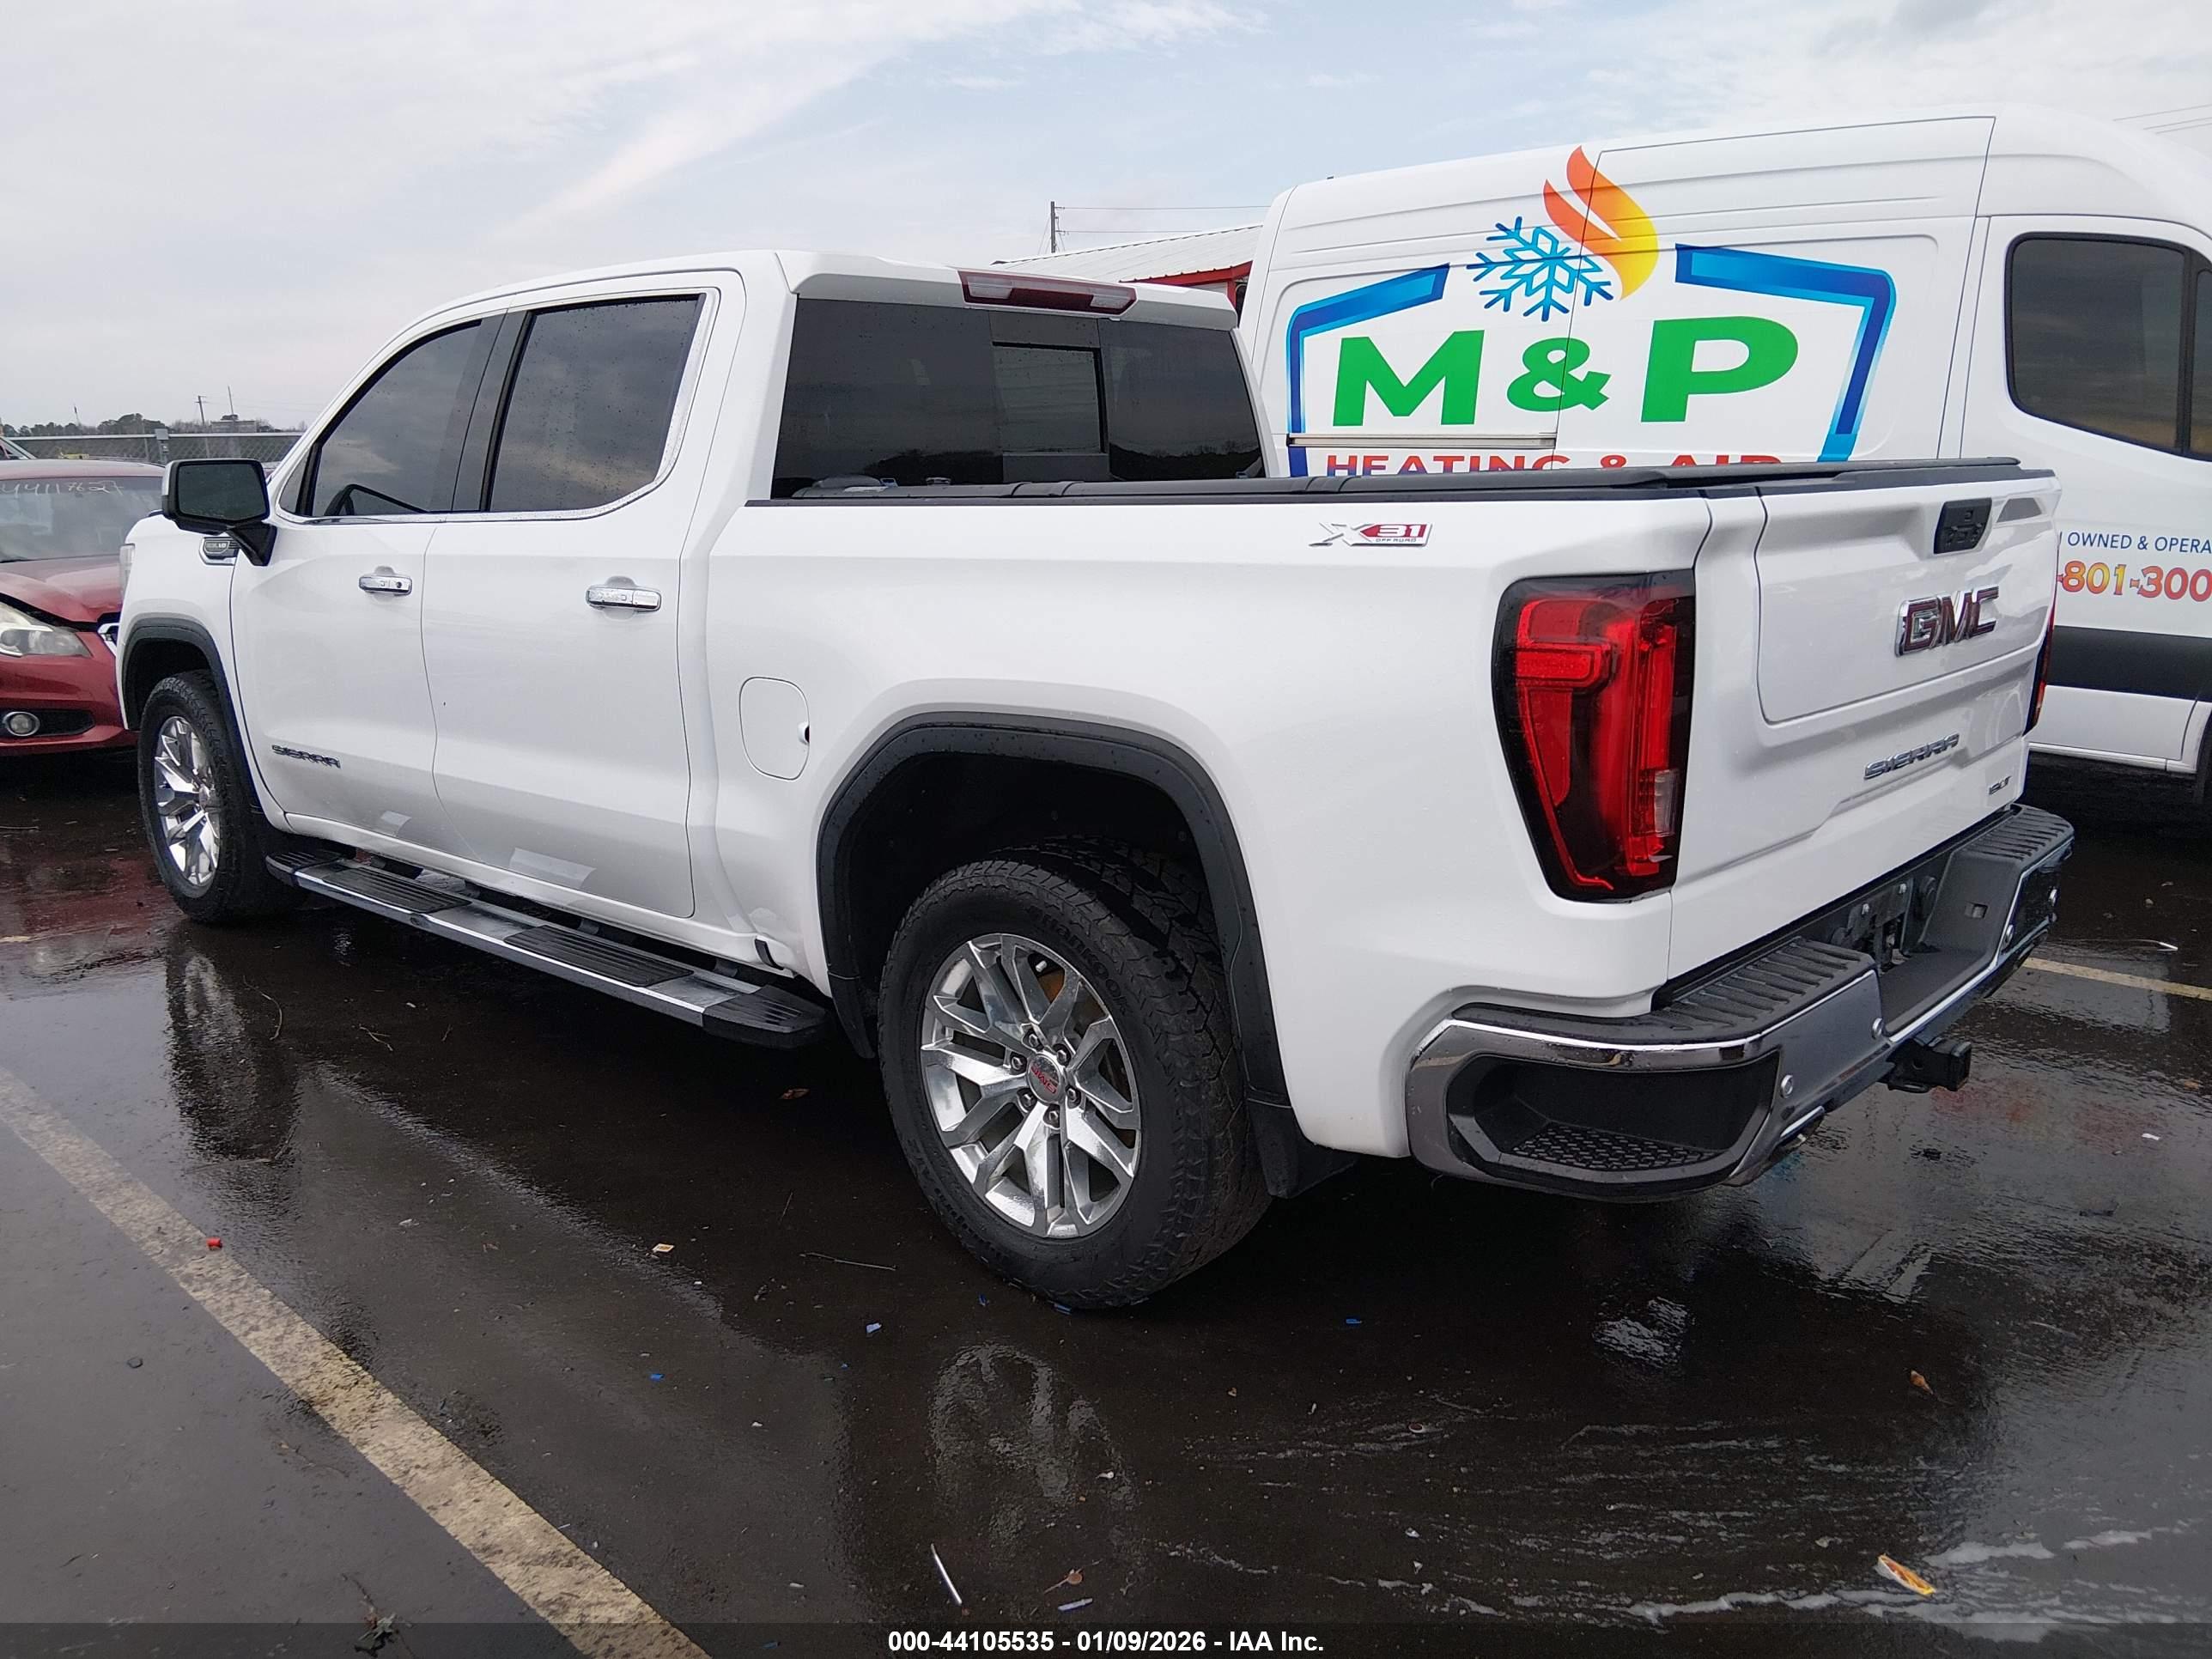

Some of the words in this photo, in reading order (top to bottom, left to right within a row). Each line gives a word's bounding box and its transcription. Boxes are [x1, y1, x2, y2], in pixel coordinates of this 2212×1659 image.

[1333, 330, 1485, 427] M
[1506, 337, 1612, 412] &
[1641, 315, 1799, 422] P
[2068, 532, 2132, 549] OWNED
[2137, 535, 2149, 550] &
[1894, 584, 1999, 657] GMC
